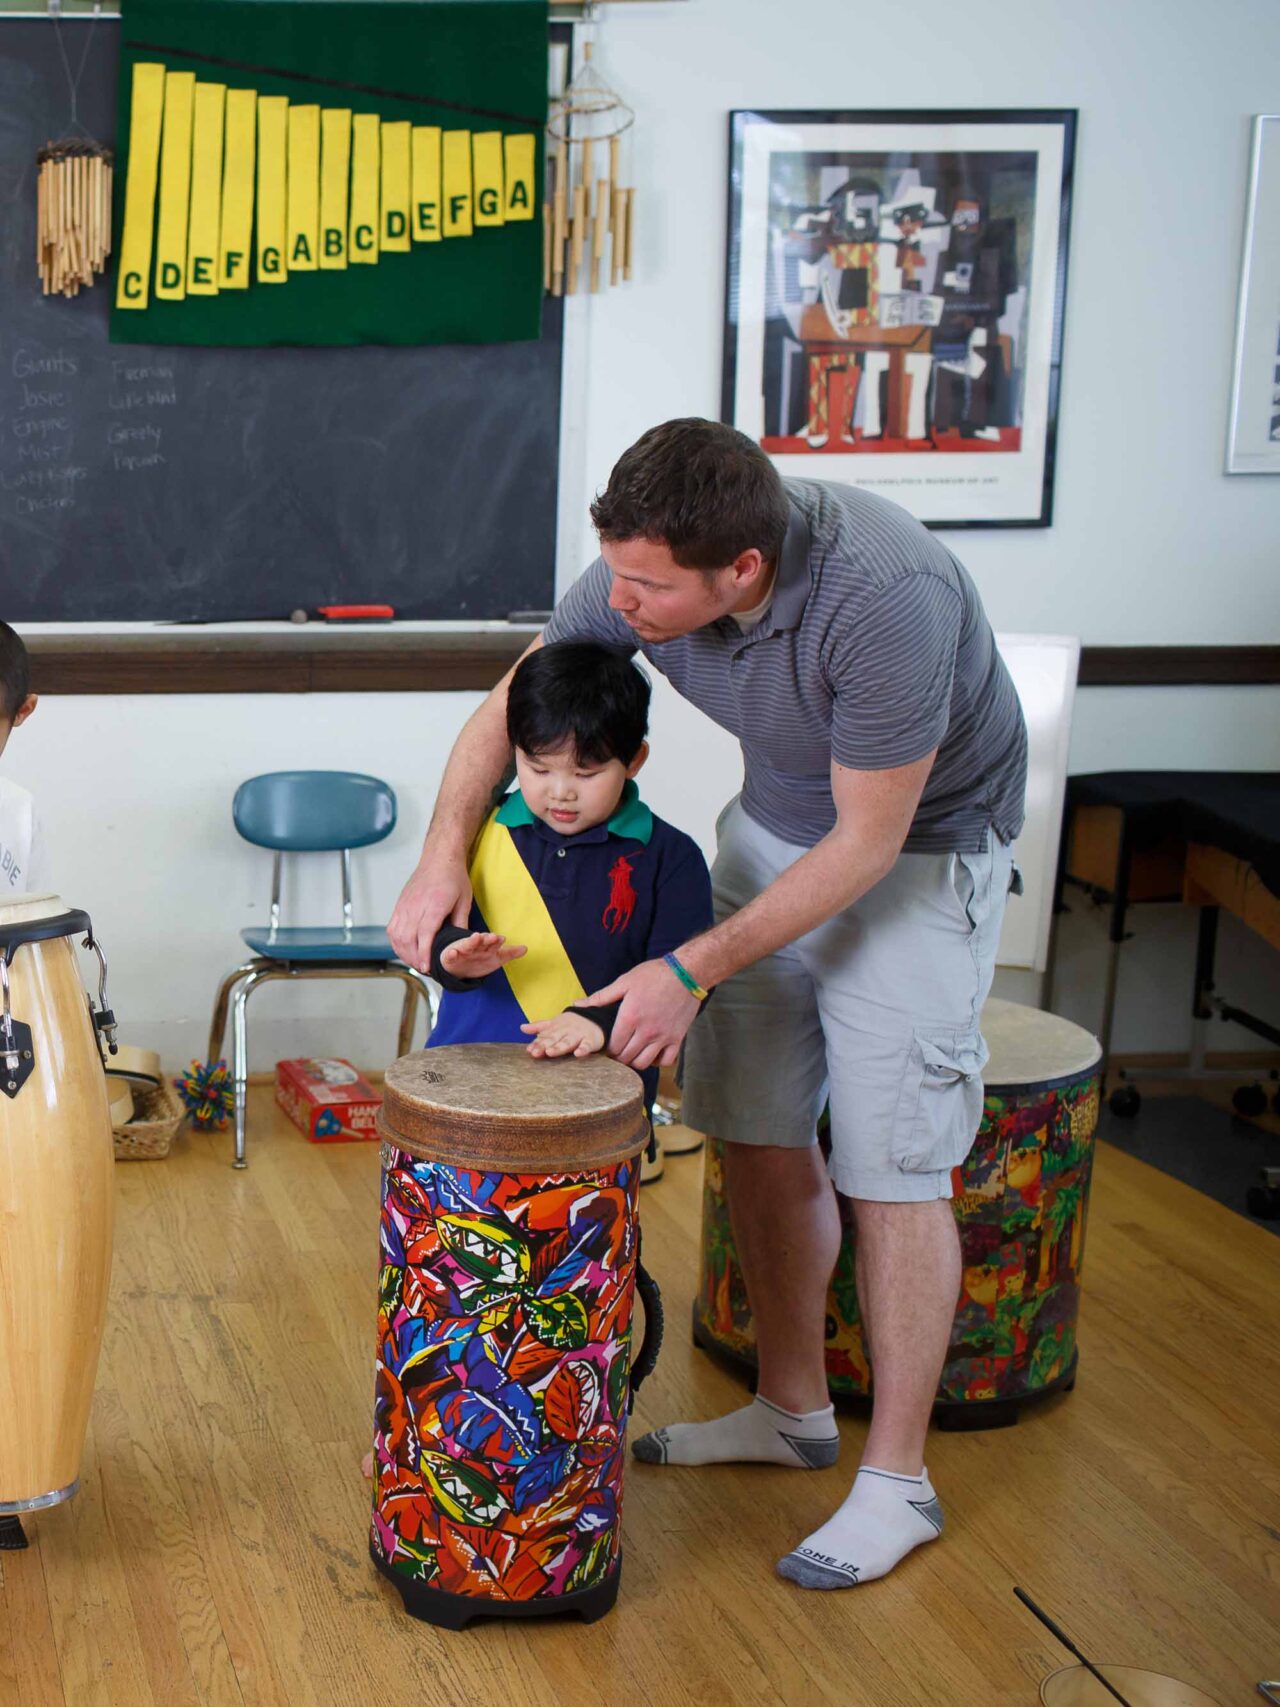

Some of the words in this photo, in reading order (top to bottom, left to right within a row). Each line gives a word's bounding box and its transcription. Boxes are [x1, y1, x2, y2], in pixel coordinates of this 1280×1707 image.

[123, 272, 142, 299] C
[162, 263, 182, 289] D
[193, 257, 213, 285] E
[226, 251, 243, 278] F
[263, 248, 281, 273] G
[293, 234, 312, 262] A
[325, 229, 342, 256] B
[355, 225, 373, 251] C
[388, 211, 406, 238] D
[419, 203, 436, 230] E
[451, 195, 468, 224] F
[480, 189, 499, 215] G
[509, 181, 528, 209] A
[840, 1562, 860, 1573] IN
